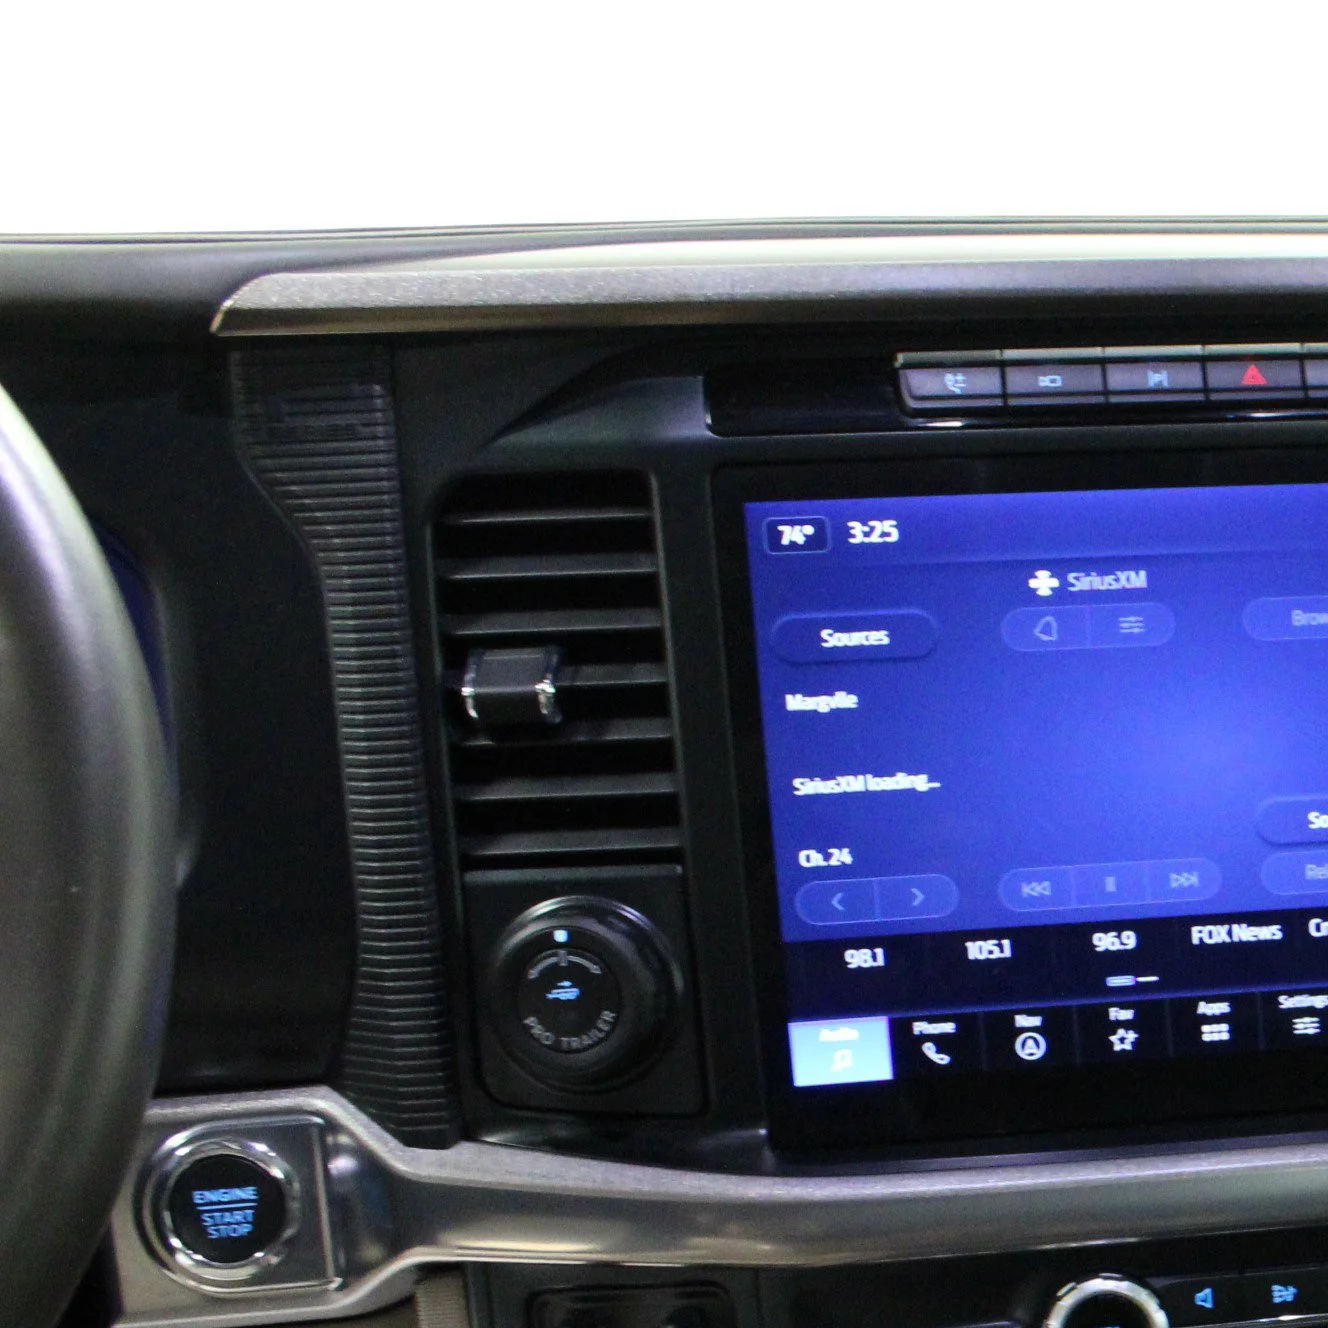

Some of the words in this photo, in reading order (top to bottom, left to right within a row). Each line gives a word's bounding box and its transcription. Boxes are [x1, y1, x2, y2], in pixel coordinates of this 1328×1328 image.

[777, 525, 814, 545] 74°
[847, 520, 898, 544] 3:25
[1066, 571, 1148, 591] SiriusXM
[819, 629, 890, 648] Sources
[792, 776, 864, 795] SiriusXM
[828, 849, 853, 866] 24
[1091, 931, 1137, 951] 96.9
[1191, 924, 1231, 945] FOX
[1233, 923, 1283, 943] News
[843, 948, 885, 969] 98.1
[964, 939, 1012, 960] 105.1
[1196, 1000, 1231, 1015] Apps
[911, 1021, 956, 1035] Phone
[1014, 1014, 1042, 1027] Nav
[192, 1187, 259, 1204] ENGINE
[203, 1210, 255, 1225] START
[208, 1224, 253, 1238] STOP
